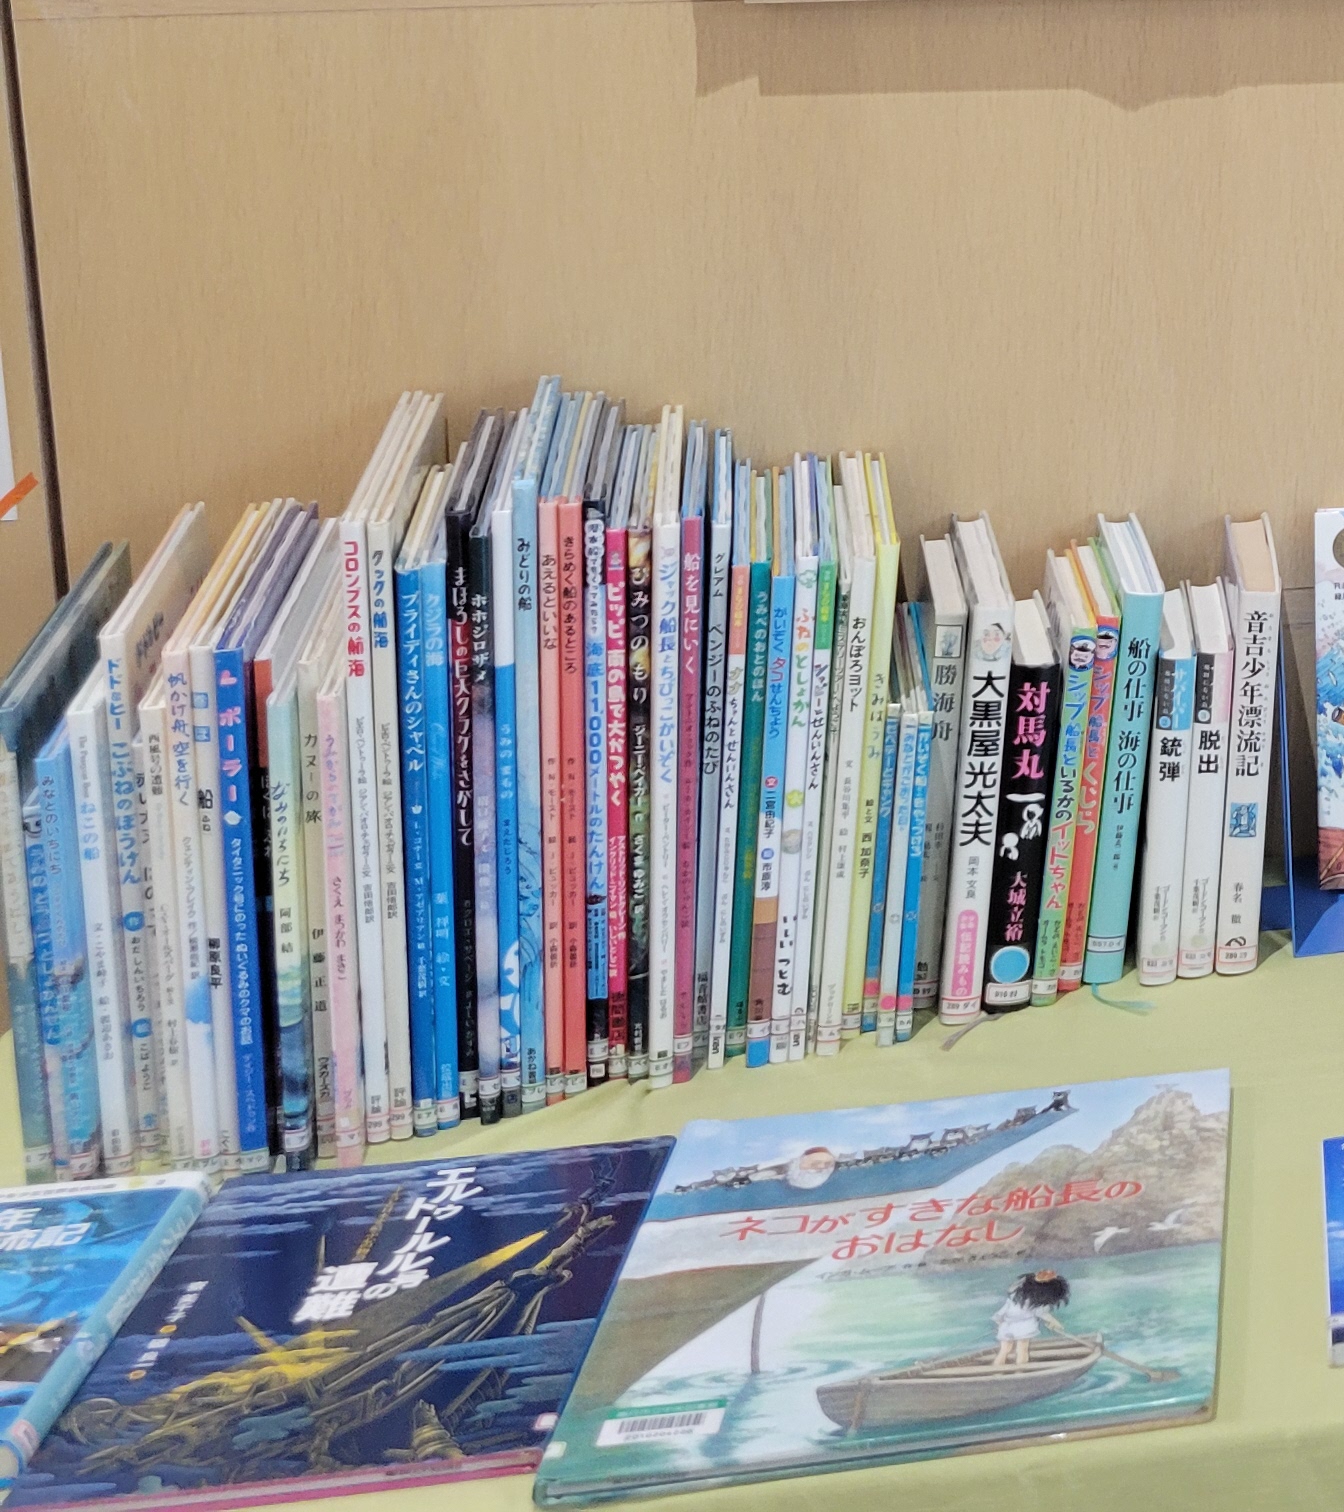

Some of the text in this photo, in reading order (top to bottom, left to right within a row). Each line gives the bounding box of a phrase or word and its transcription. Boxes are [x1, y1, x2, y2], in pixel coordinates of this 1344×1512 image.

[344, 540, 366, 678] コロンブスの航海
[371, 549, 390, 649] クックの航海
[424, 593, 444, 667] クジラの海
[516, 537, 533, 612] みどりの船
[541, 554, 557, 651] あえるといいな
[562, 536, 578, 675] きらめく船のあるところ
[683, 552, 701, 675] 船を見にいく
[471, 593, 490, 683] ホホジロザメ
[658, 562, 678, 784] ジャック船長とちびっこかいぞく
[702, 552, 726, 775] グレアム ベンジーのふねのたび
[751, 590, 769, 703] うみべのおとのほん
[791, 608, 816, 728] ふねのとしょかん
[849, 616, 867, 713] おんぼろヨット
[1234, 610, 1269, 778] 音吉少年漂流記
[452, 566, 474, 846] まぼろしの巨大クラゲをさがして
[867, 673, 886, 759] きみはうみ
[932, 664, 957, 741] 勝海舟
[959, 670, 1007, 847] 大黒屋光太夫
[1077, 666, 1112, 835] シップ船長とくじら
[1113, 637, 1151, 815] 船の仕事 海の仕事
[1159, 736, 1183, 782] 銃弾
[1197, 729, 1221, 775] 脱出
[1004, 681, 1051, 942] 対馬丸 大城立裕
[1045, 674, 1088, 910] シップ船長といるかのイットちゃん
[303, 733, 328, 1012] カヌーの旅 伊藤正道
[718, 1176, 1144, 1242] ネコがすきな船長の
[829, 1218, 1025, 1262] おはなし
[290, 1261, 379, 1324] 遭難
